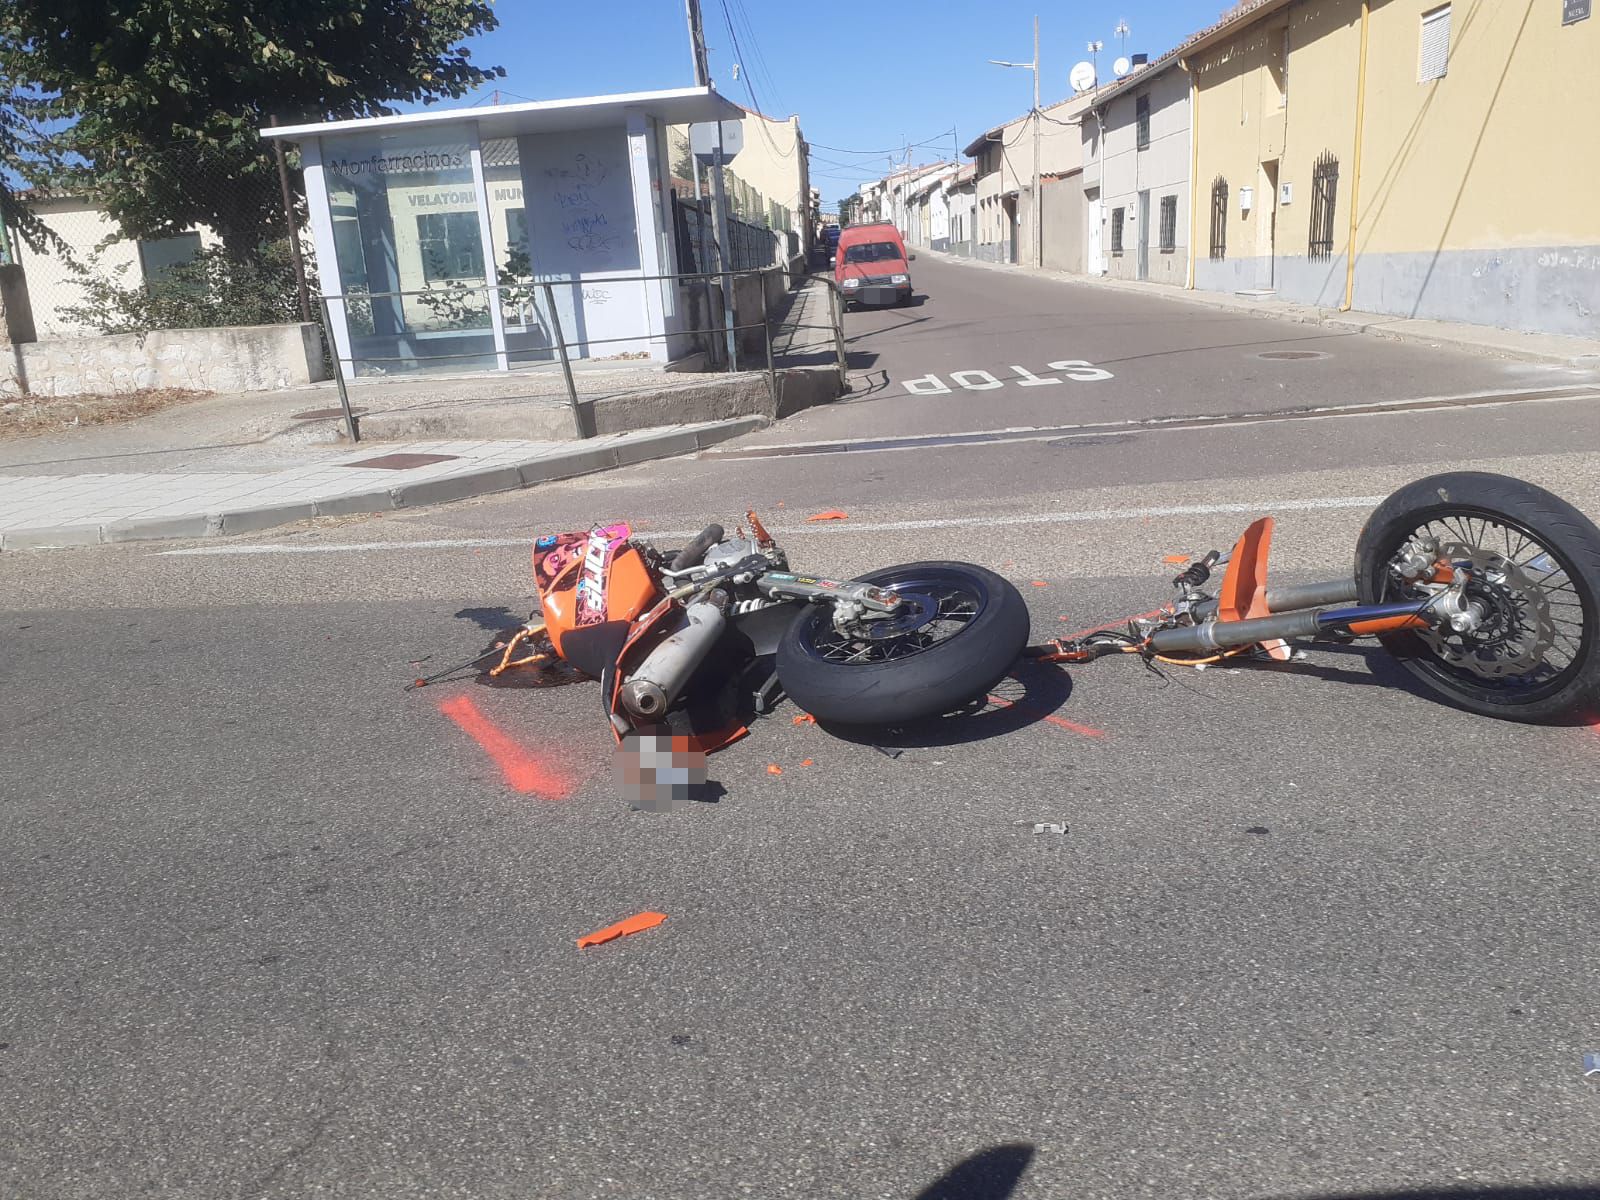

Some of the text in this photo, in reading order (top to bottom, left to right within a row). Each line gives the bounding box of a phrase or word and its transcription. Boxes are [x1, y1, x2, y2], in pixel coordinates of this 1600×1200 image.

[331, 150, 463, 177] Monfarracinos
[408, 191, 477, 207] VELATORI
[901, 360, 1114, 395] STOP
